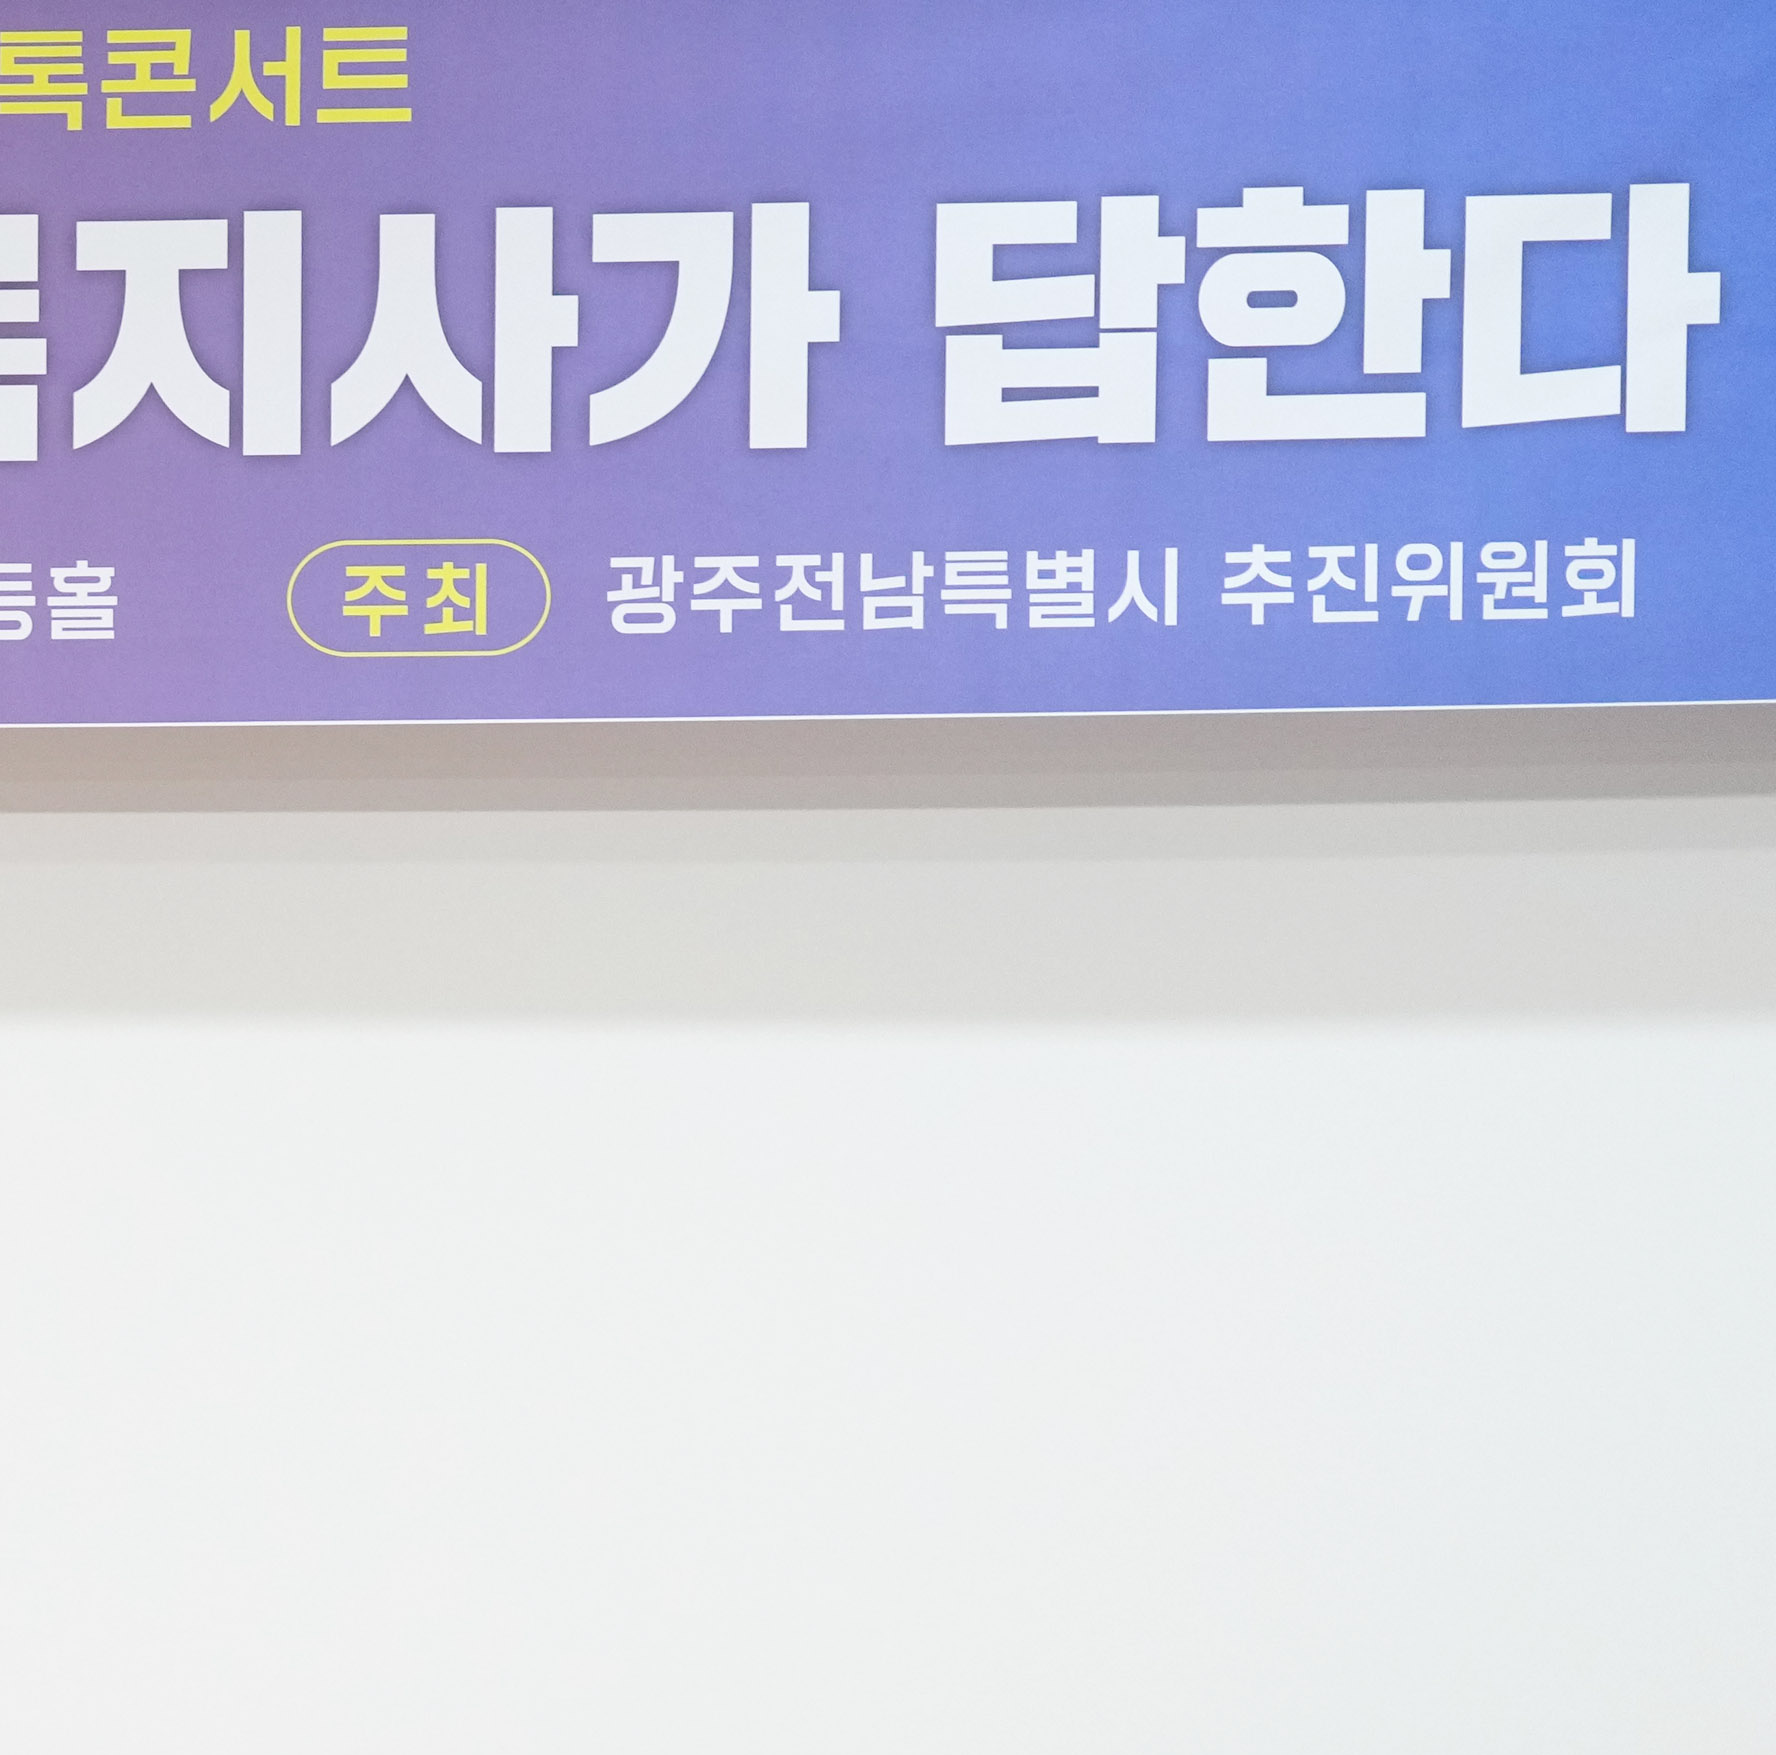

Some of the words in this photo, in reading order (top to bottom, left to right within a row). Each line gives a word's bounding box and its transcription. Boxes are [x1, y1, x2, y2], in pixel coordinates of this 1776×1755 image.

[934, 183, 1722, 447] 답한다
[342, 561, 488, 637] 주최
[605, 546, 1179, 637] 광주전남특별시
[1220, 536, 1637, 627] 추진위원회
